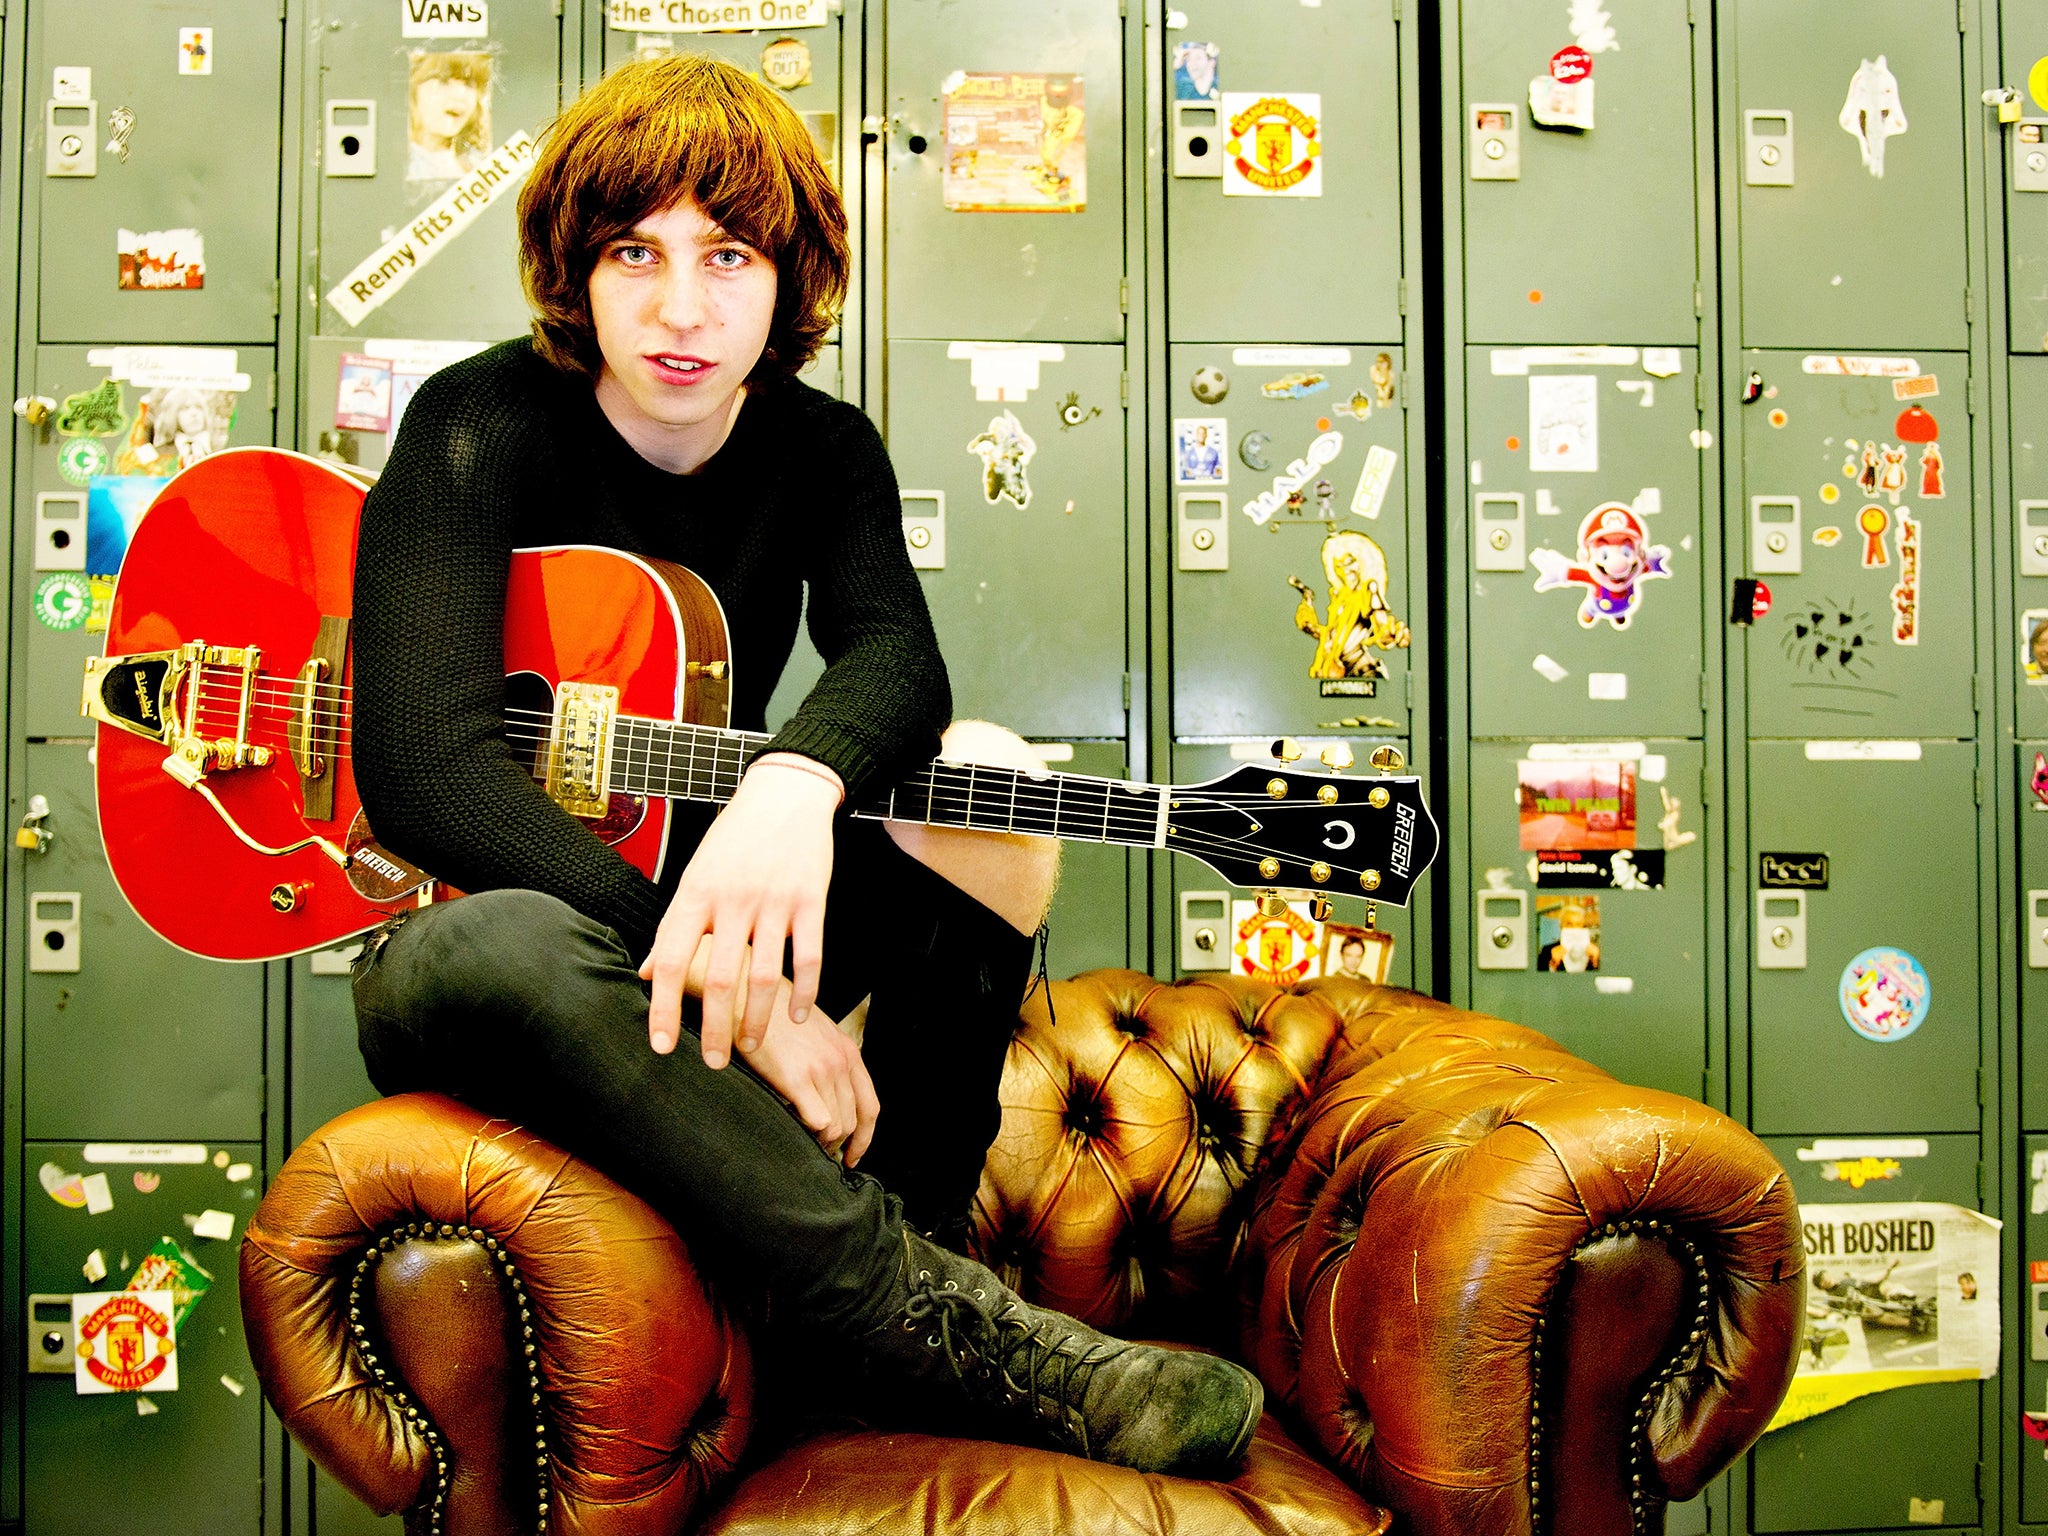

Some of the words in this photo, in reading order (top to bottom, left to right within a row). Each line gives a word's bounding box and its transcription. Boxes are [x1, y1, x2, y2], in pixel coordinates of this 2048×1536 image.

[411, 0, 482, 22] VANS
[612, 4, 651, 22] the
[349, 244, 416, 304] Remy
[413, 211, 453, 247] fits
[453, 160, 510, 213] right
[509, 139, 533, 164] in
[1390, 802, 1416, 879] GRETSCH
[354, 847, 408, 883] GRETSCH
[1539, 862, 1566, 873] david
[1567, 862, 1598, 873] bowie
[1843, 1220, 1935, 1254] BOSHED
[87, 1302, 163, 1334] MANCHESTER
[101, 1367, 155, 1386] UNITED
